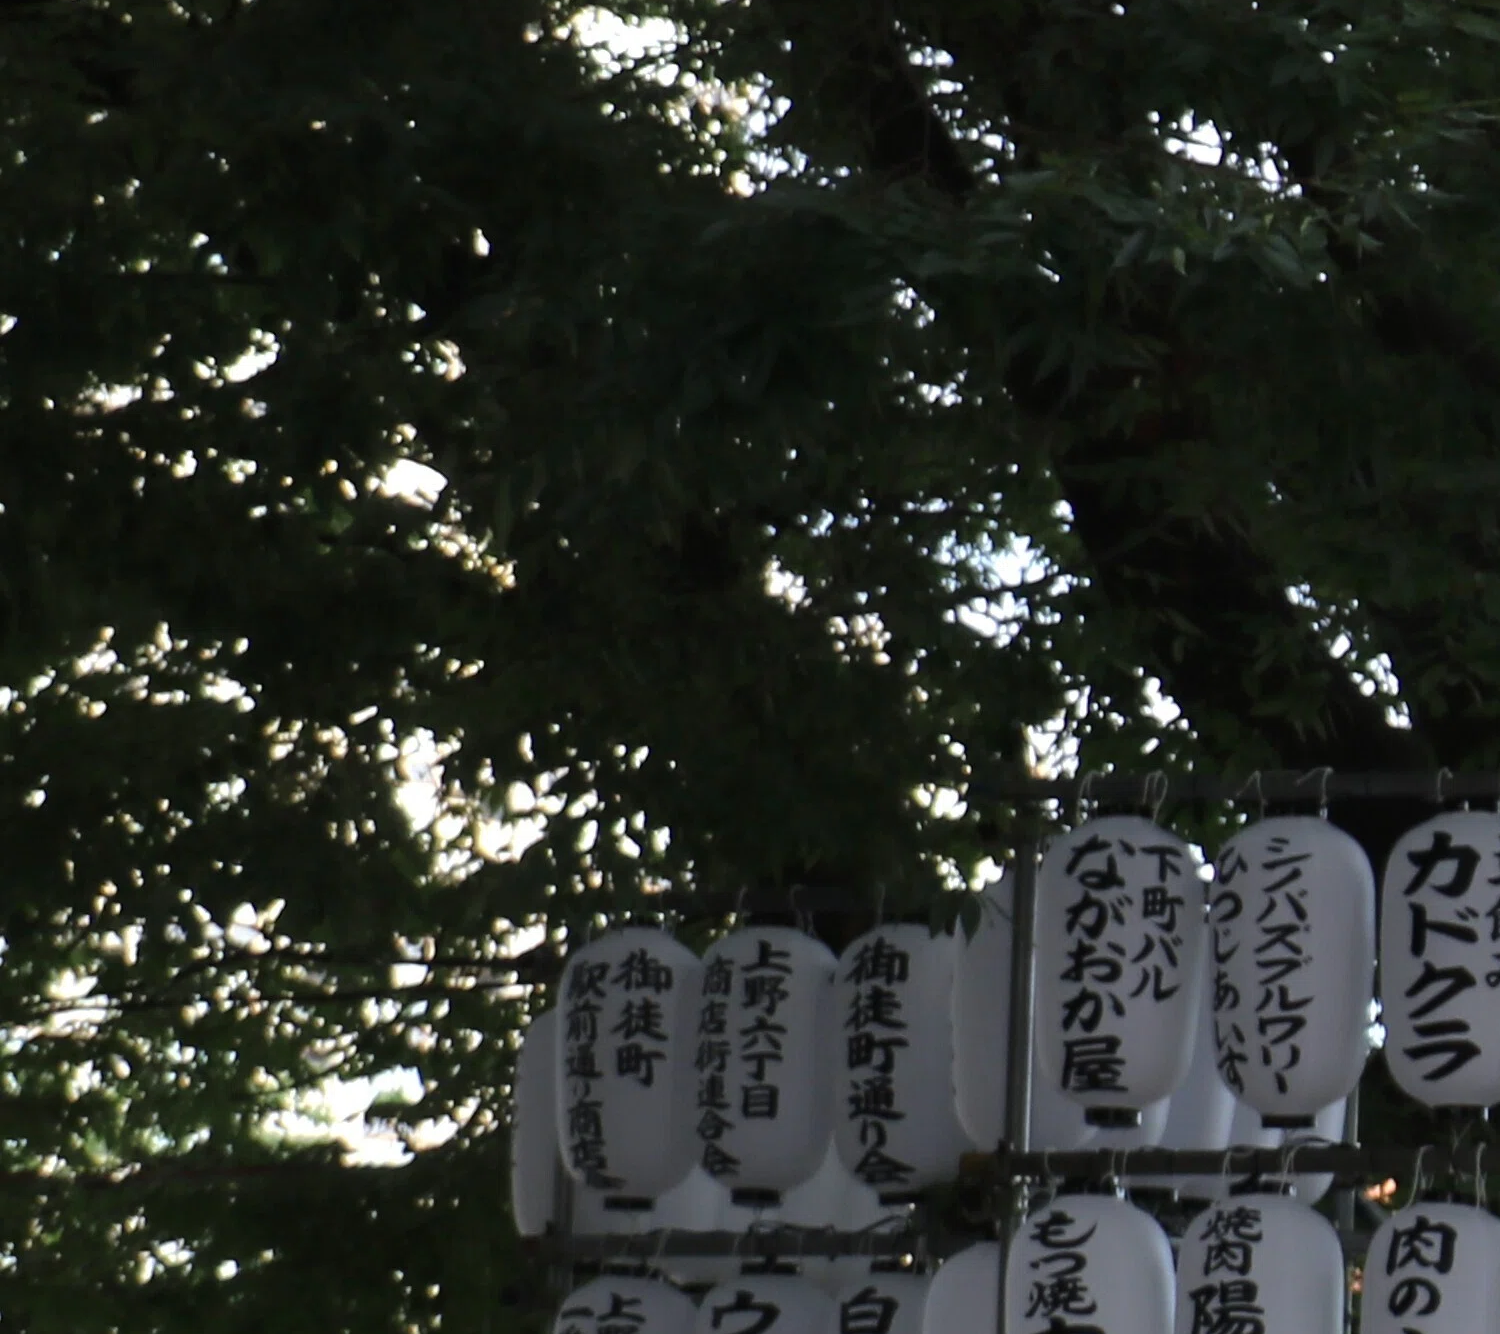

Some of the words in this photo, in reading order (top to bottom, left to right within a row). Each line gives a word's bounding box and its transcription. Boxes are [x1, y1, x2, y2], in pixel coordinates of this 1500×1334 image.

[611, 947, 674, 1089] 御徒町
[739, 939, 793, 1121] 上野六丁目
[1058, 835, 1137, 1094] ながおか屋
[1131, 844, 1186, 1004] 下町バル
[1210, 846, 1249, 1096] ひつじあいす
[1253, 837, 1314, 1095] シノバズブルワリー
[1403, 830, 1482, 1083] カドクラ
[695, 955, 741, 1179] 商店街連合会
[844, 938, 916, 1187] 御徒町通り会
